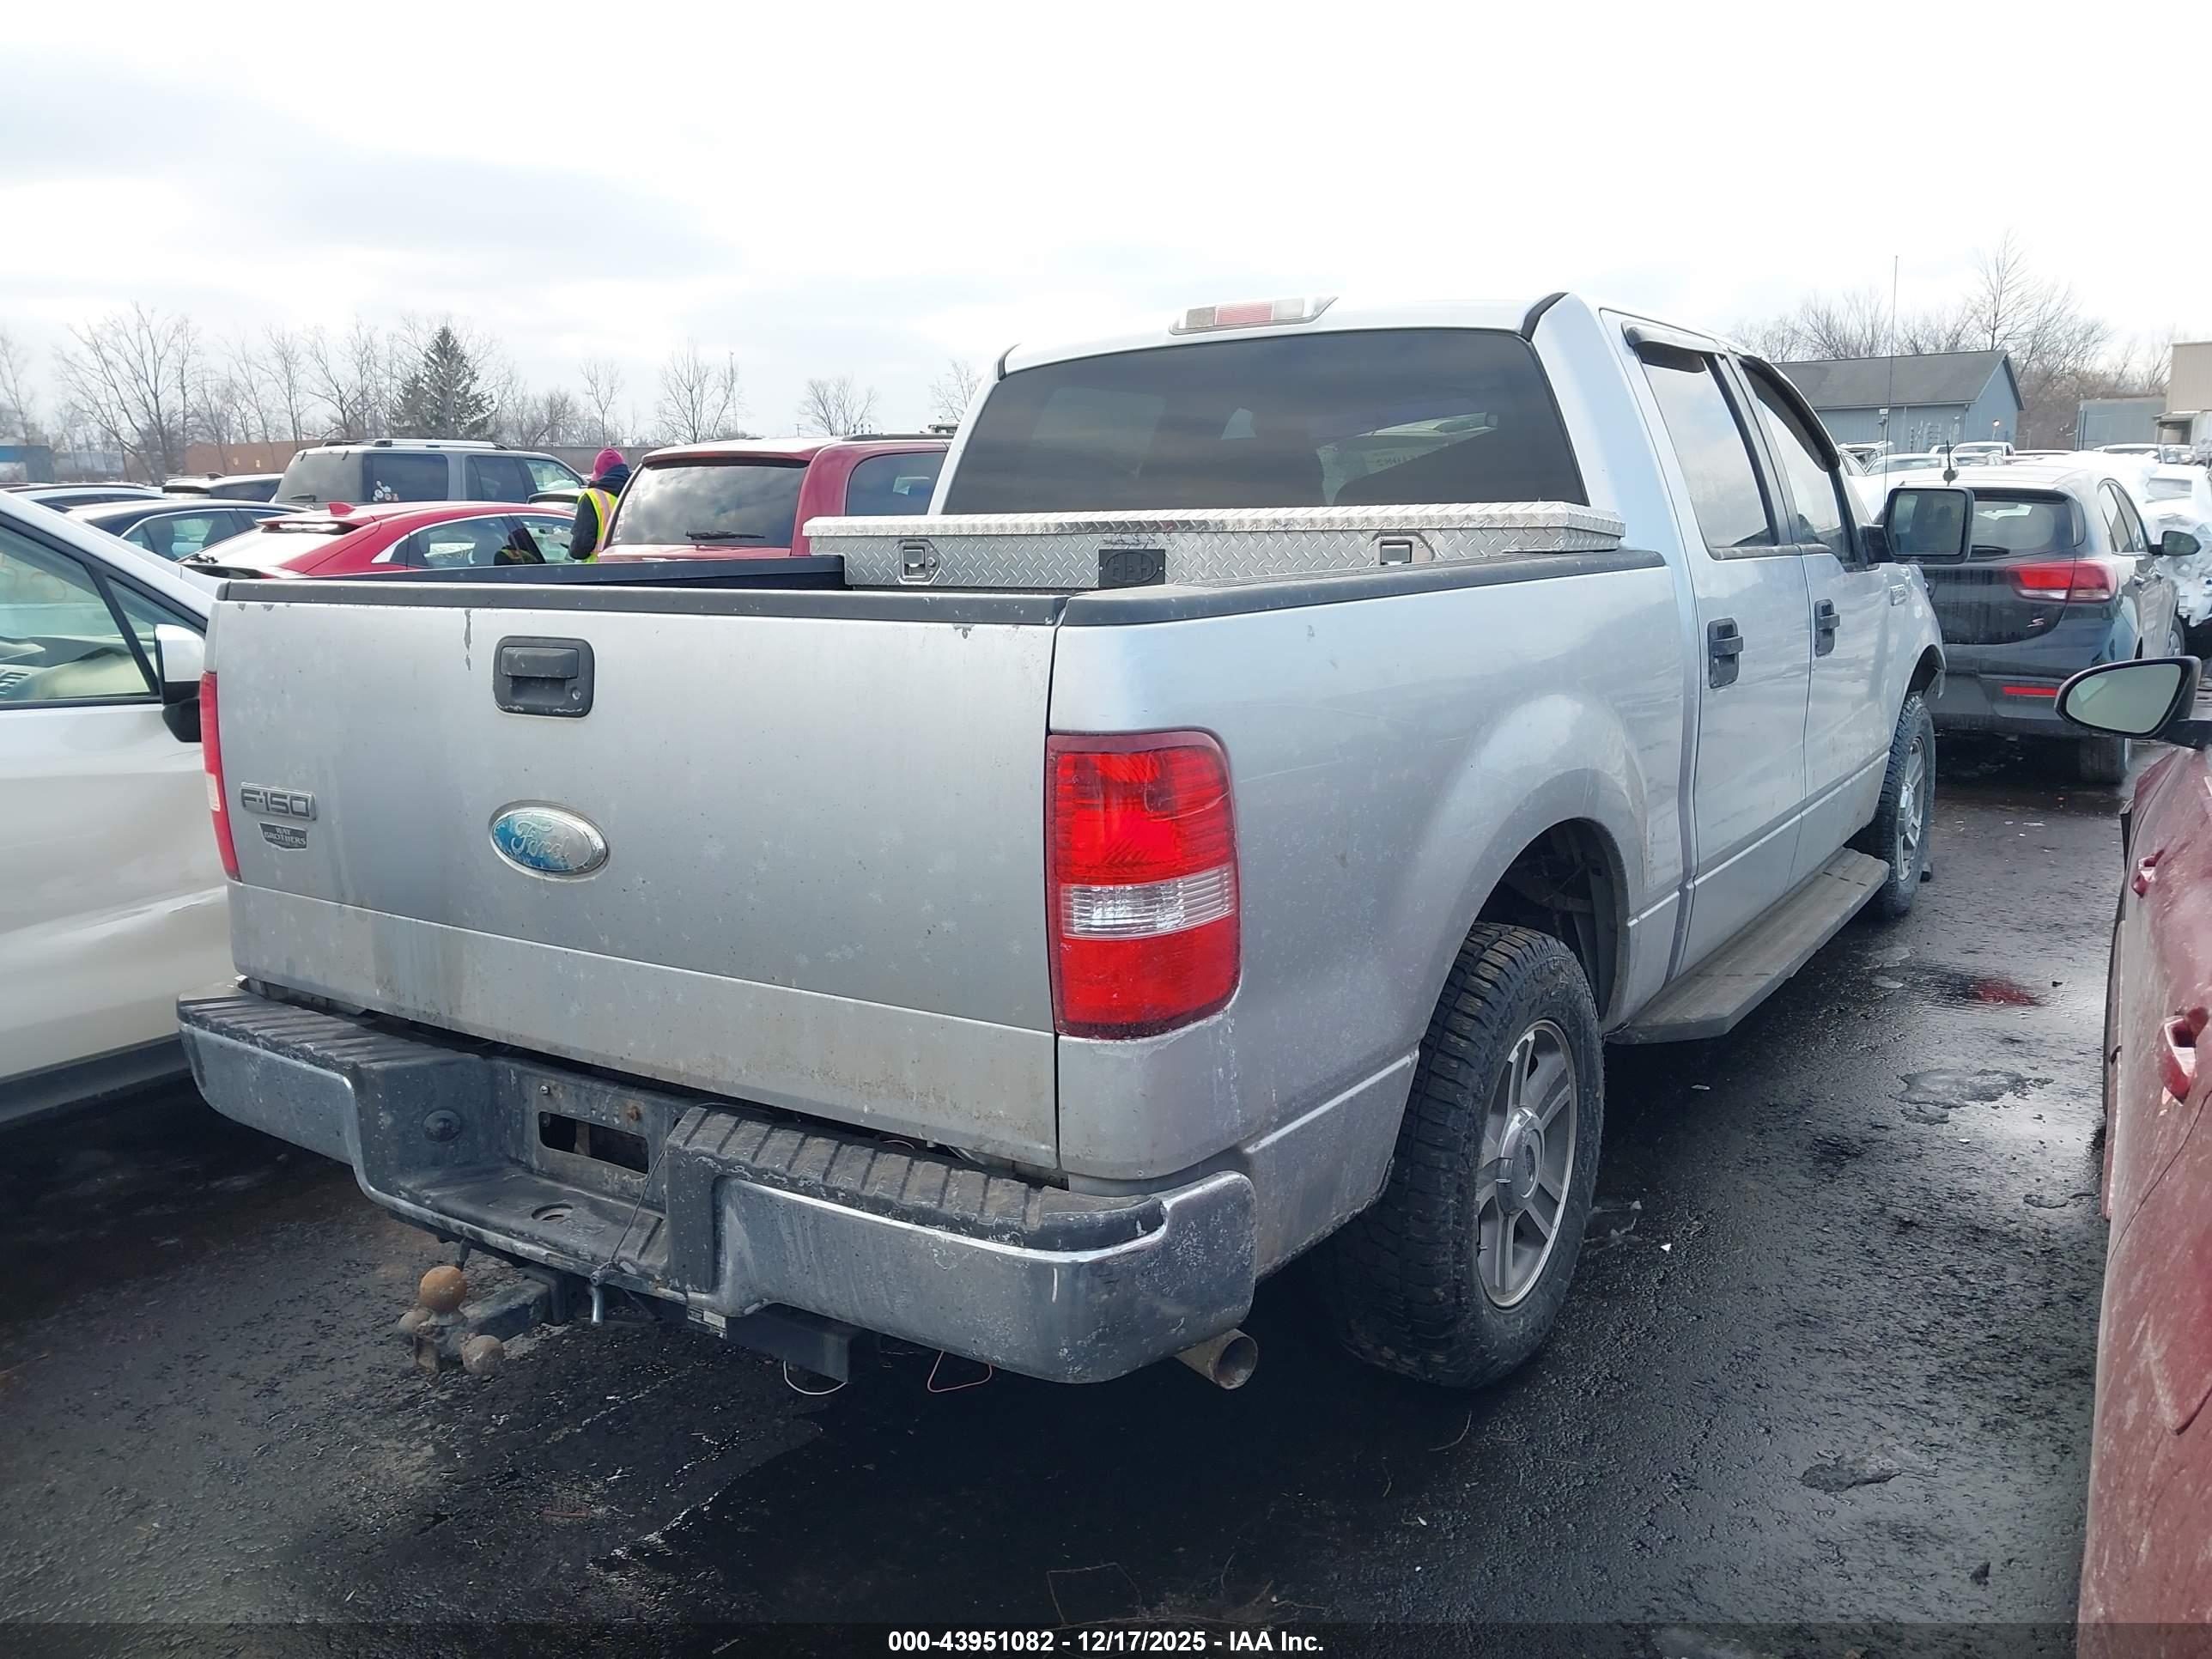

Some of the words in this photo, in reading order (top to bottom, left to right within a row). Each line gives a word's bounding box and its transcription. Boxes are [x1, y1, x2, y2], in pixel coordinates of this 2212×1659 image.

[240, 787, 311, 817] F-150
[264, 831, 307, 845] BROTHERS
[510, 820, 571, 860] Ford
